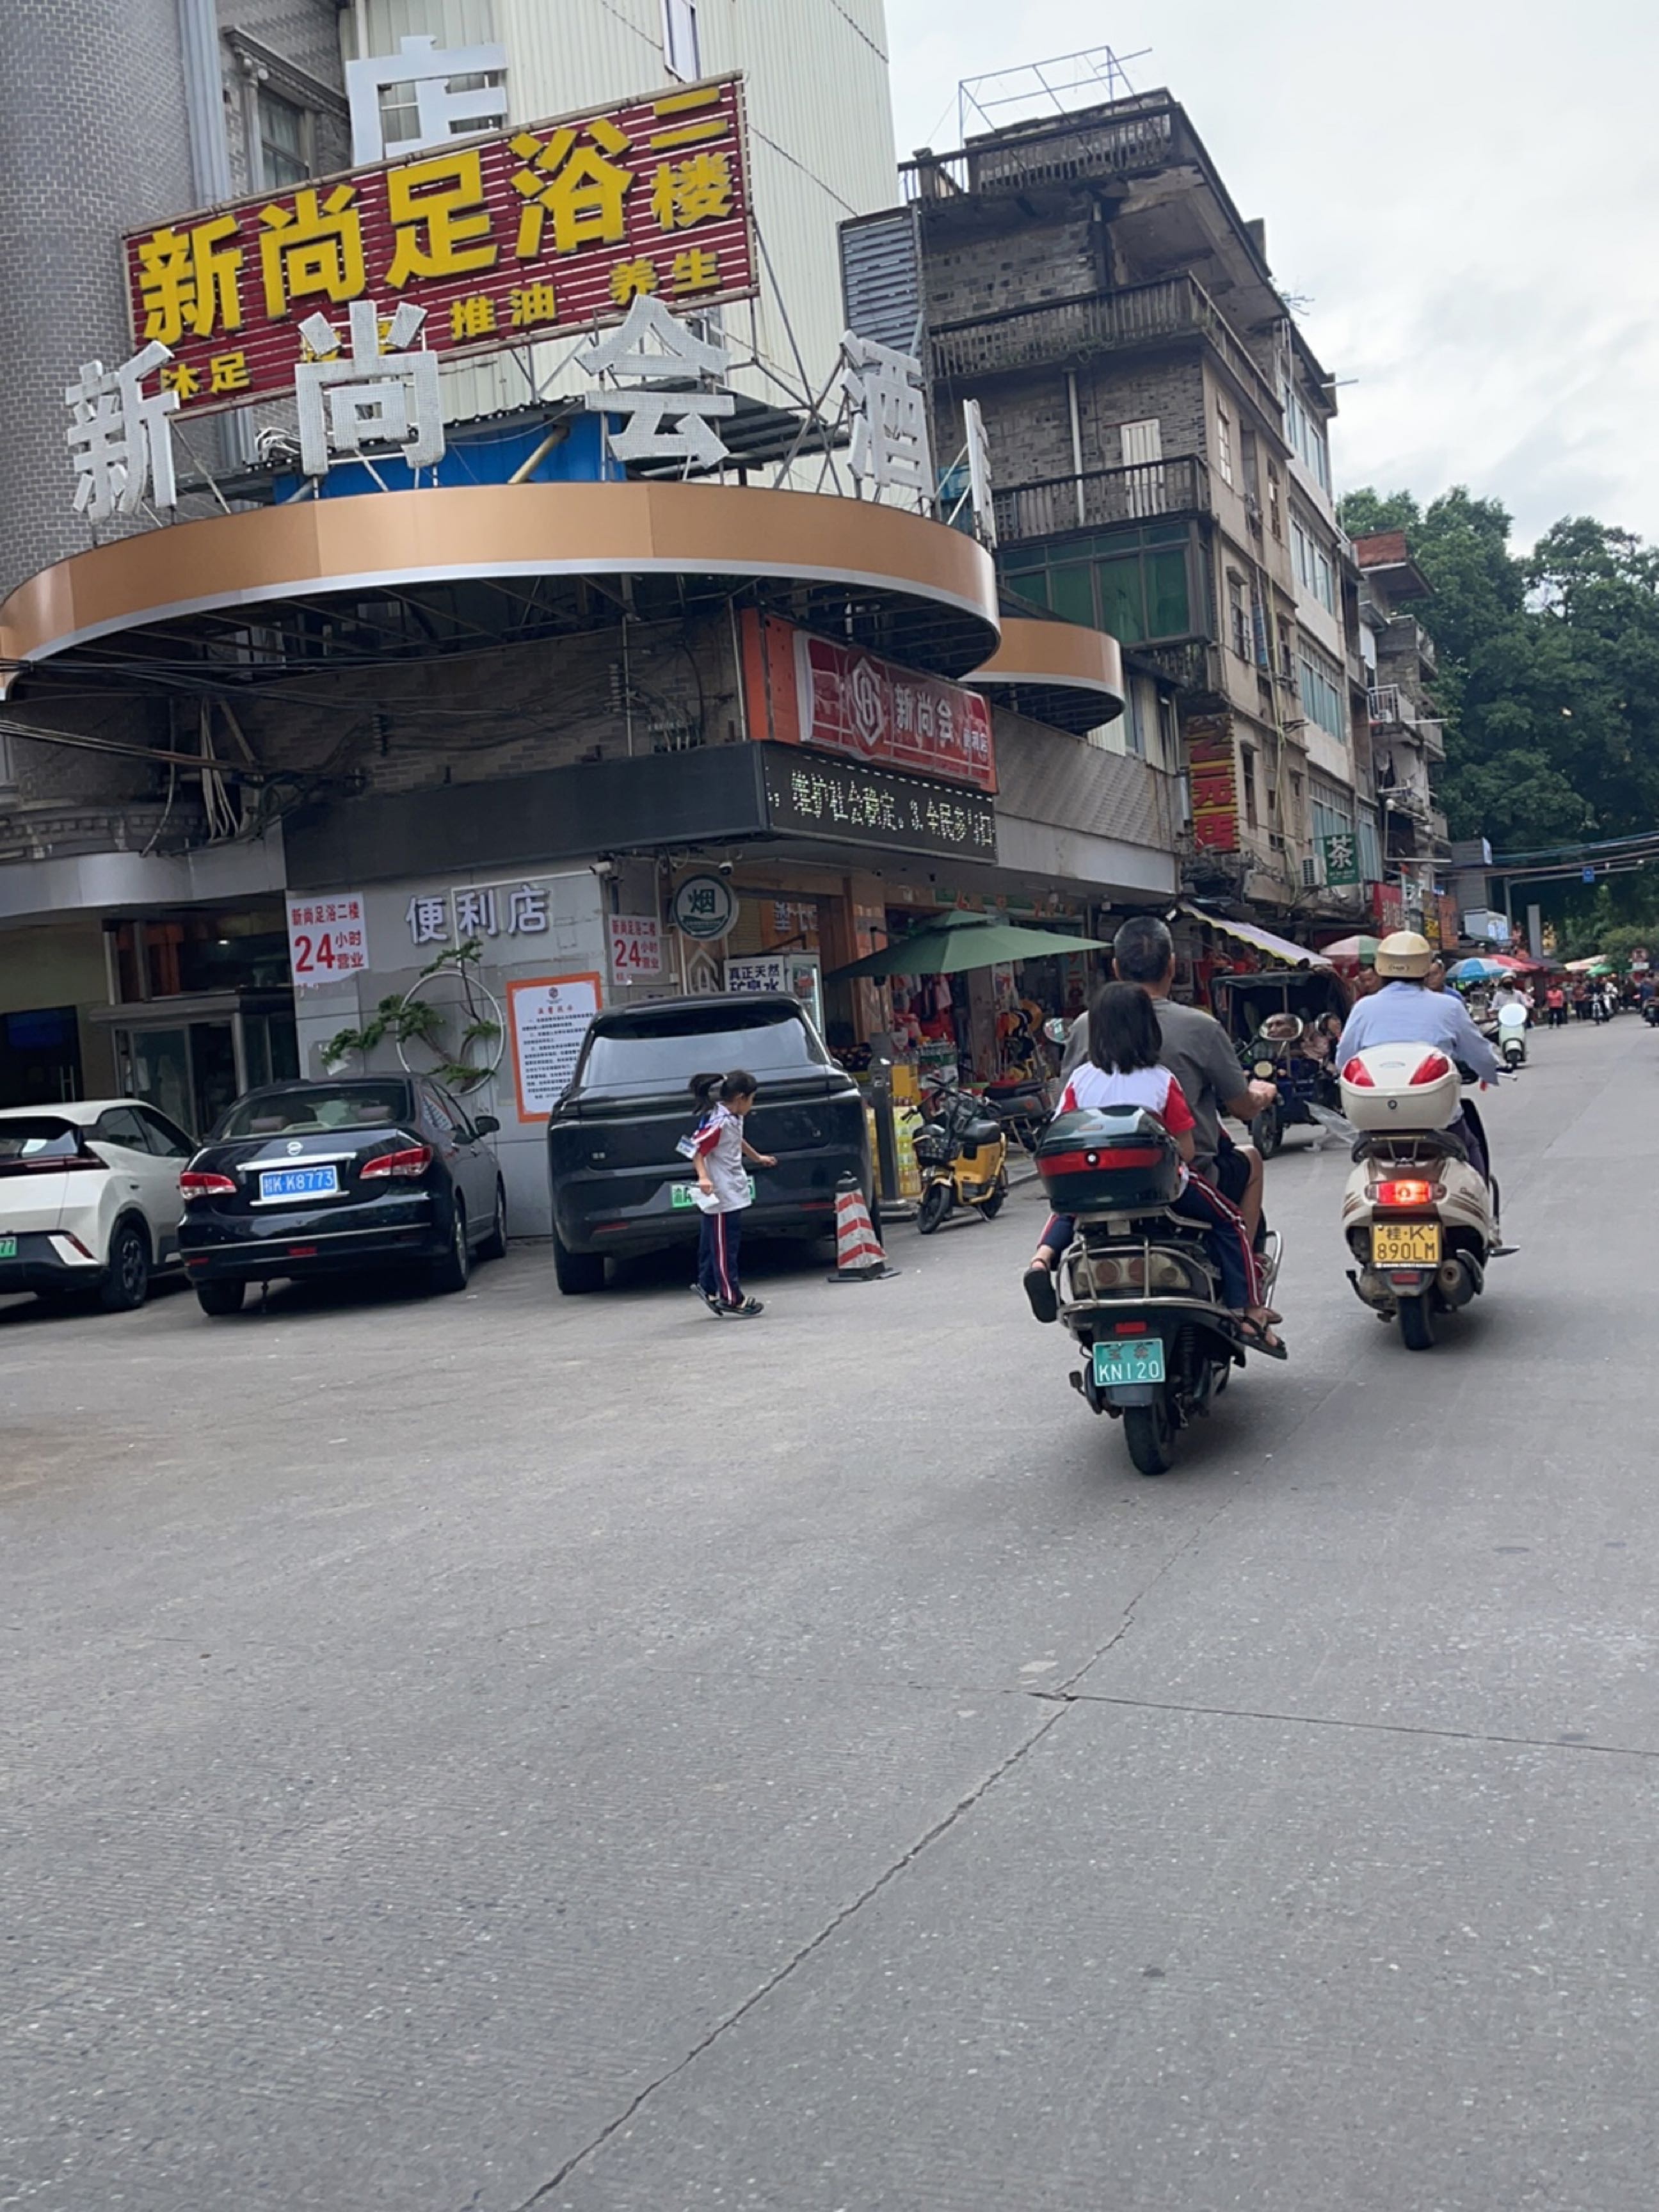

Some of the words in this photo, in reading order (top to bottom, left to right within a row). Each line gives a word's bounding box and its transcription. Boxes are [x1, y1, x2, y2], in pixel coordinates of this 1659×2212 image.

[650, 88, 733, 230] 二楼
[138, 119, 634, 346] 新尚足浴
[451, 283, 556, 339] 推油
[609, 248, 719, 305] 养生
[1326, 835, 1354, 869] 茶
[405, 885, 549, 945] 便利店
[687, 888, 716, 914] 烟
[294, 933, 335, 973] 24
[336, 930, 362, 949] 小时
[614, 939, 641, 968] 24
[337, 951, 364, 970] 营业
[1377, 1242, 1436, 1260] 890LM
